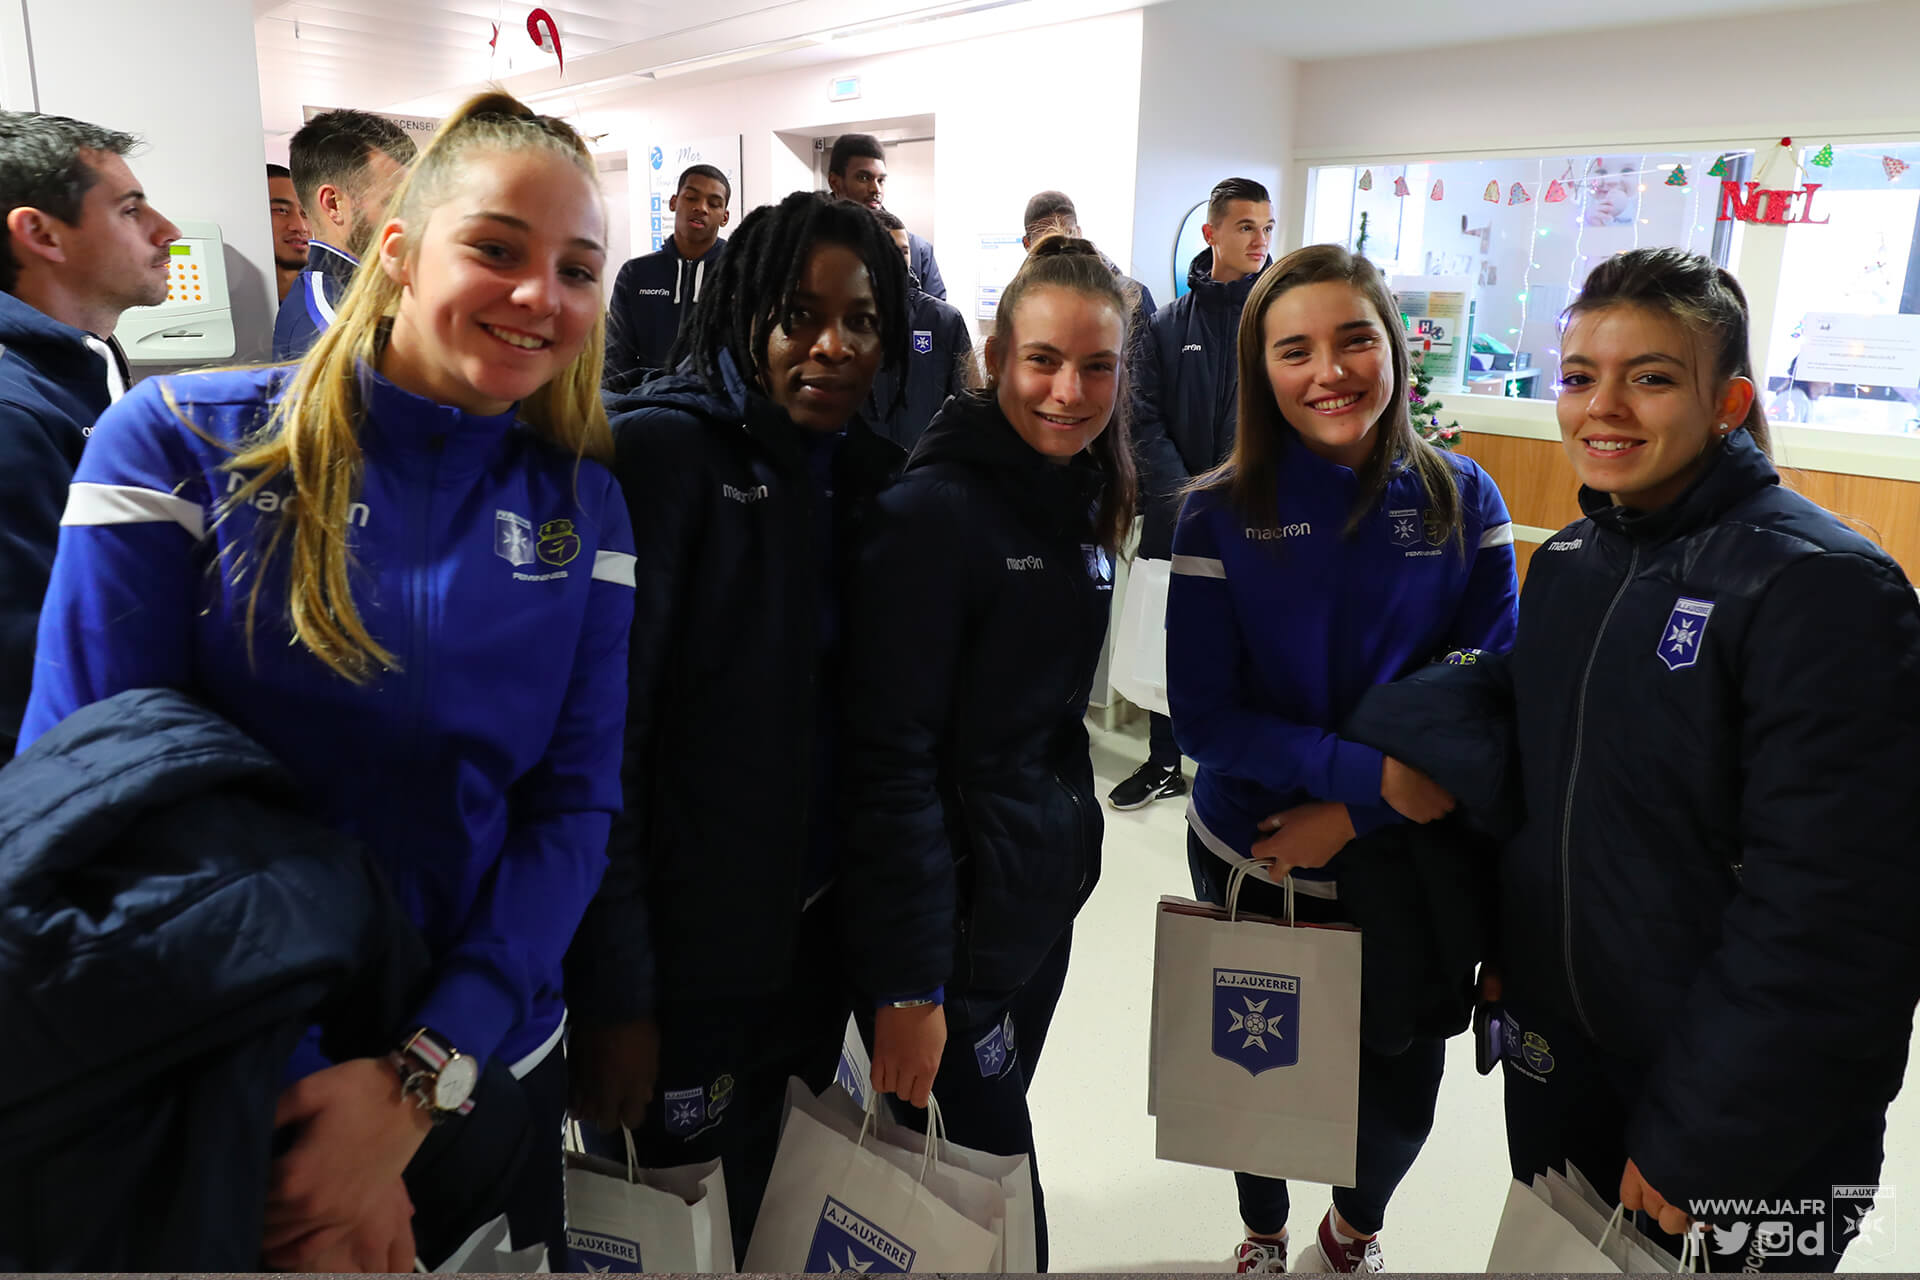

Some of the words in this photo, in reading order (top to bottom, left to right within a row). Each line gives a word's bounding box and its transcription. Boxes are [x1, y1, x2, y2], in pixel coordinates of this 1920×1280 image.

[1716, 180, 1830, 224] NOEL
[639, 288, 670, 296] macron
[1245, 522, 1311, 541] macron
[1548, 538, 1583, 551] macron
[1006, 555, 1044, 570] macron
[1218, 975, 1295, 991] A.J.AUXERRE
[827, 1207, 907, 1265] A.J.AUXERRE
